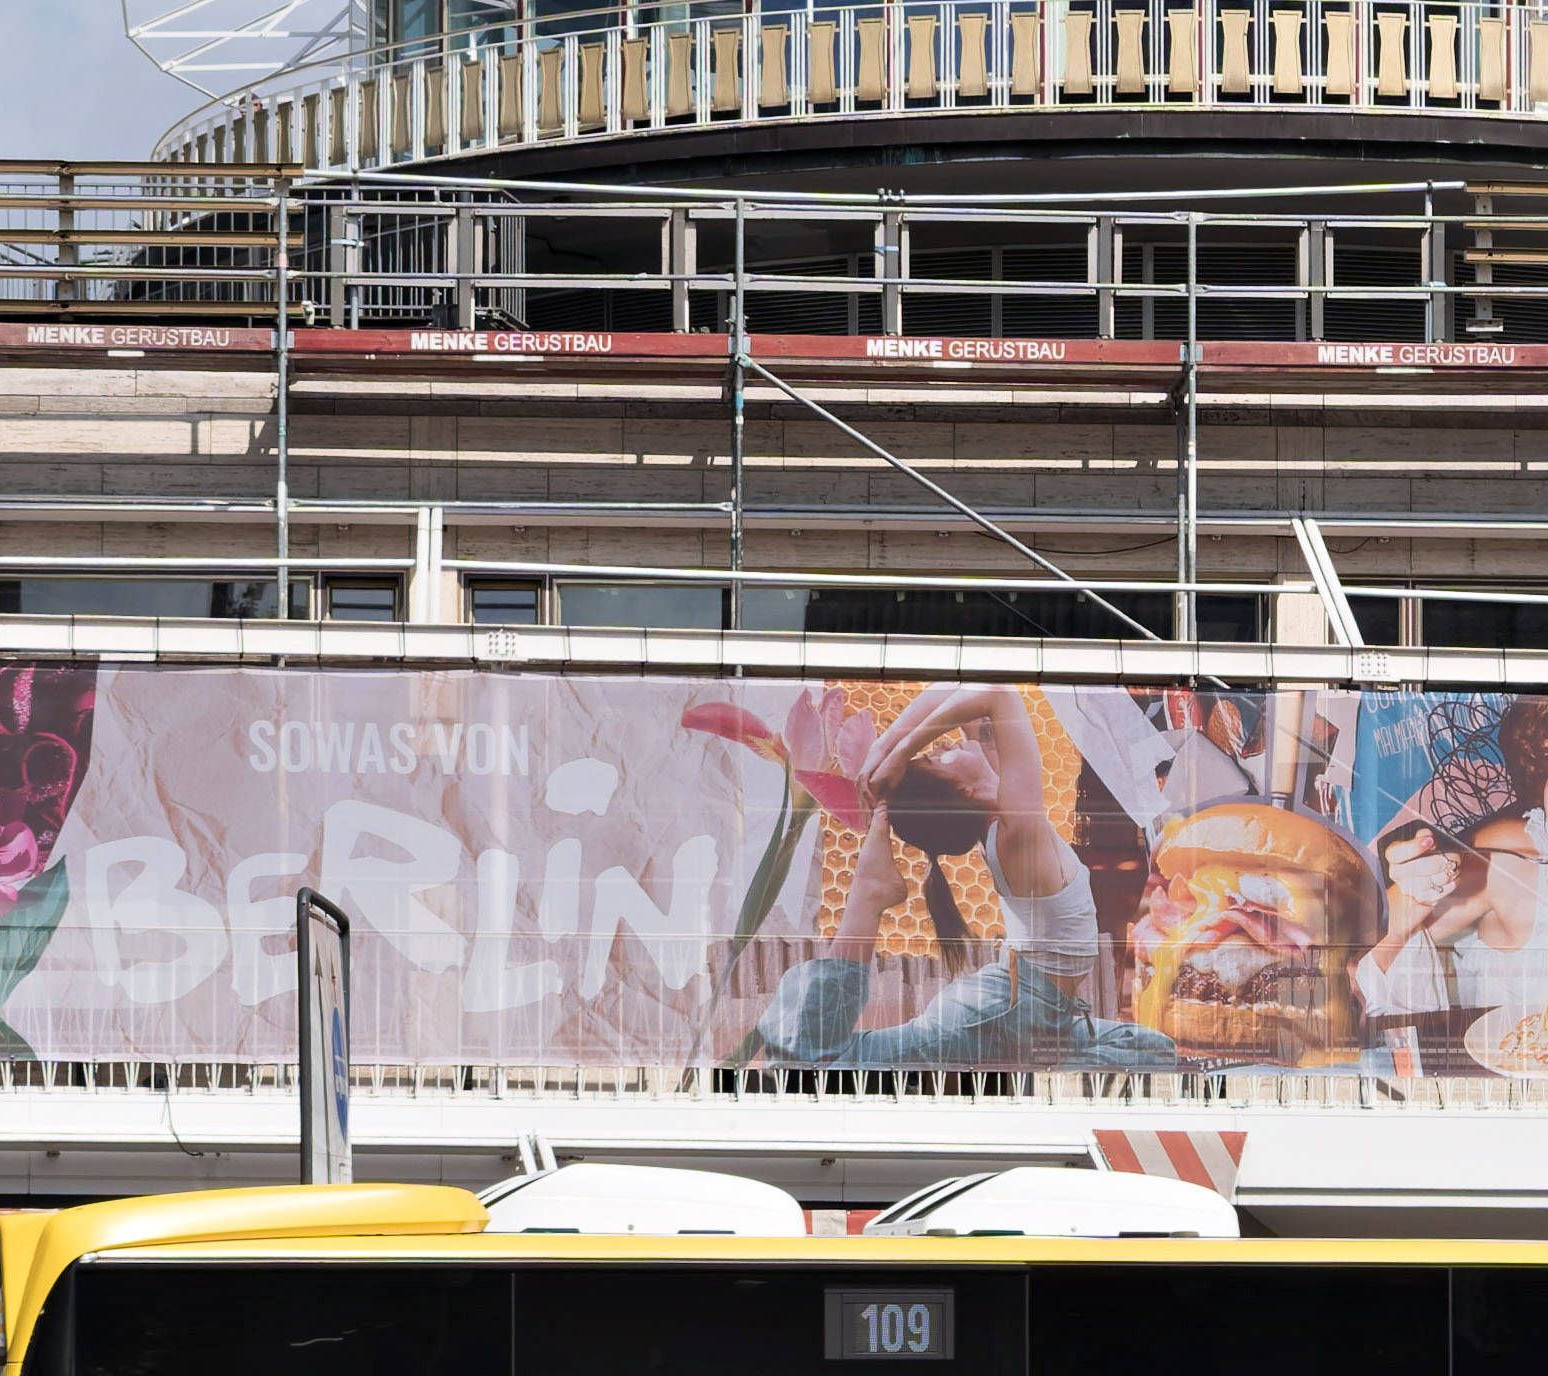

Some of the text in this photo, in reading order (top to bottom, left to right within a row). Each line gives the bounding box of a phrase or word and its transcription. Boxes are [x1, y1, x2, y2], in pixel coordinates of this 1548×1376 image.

[27, 327, 230, 346] MENKE GERÜSTBAU
[410, 333, 612, 352] MENKE GERÜSTBAU
[866, 340, 1066, 359] MENKE GERÜSTBAU
[1317, 346, 1515, 364] MENKE GERÜSTBAU
[248, 719, 529, 776] SOWAS VON
[861, 1303, 931, 1352] 109
